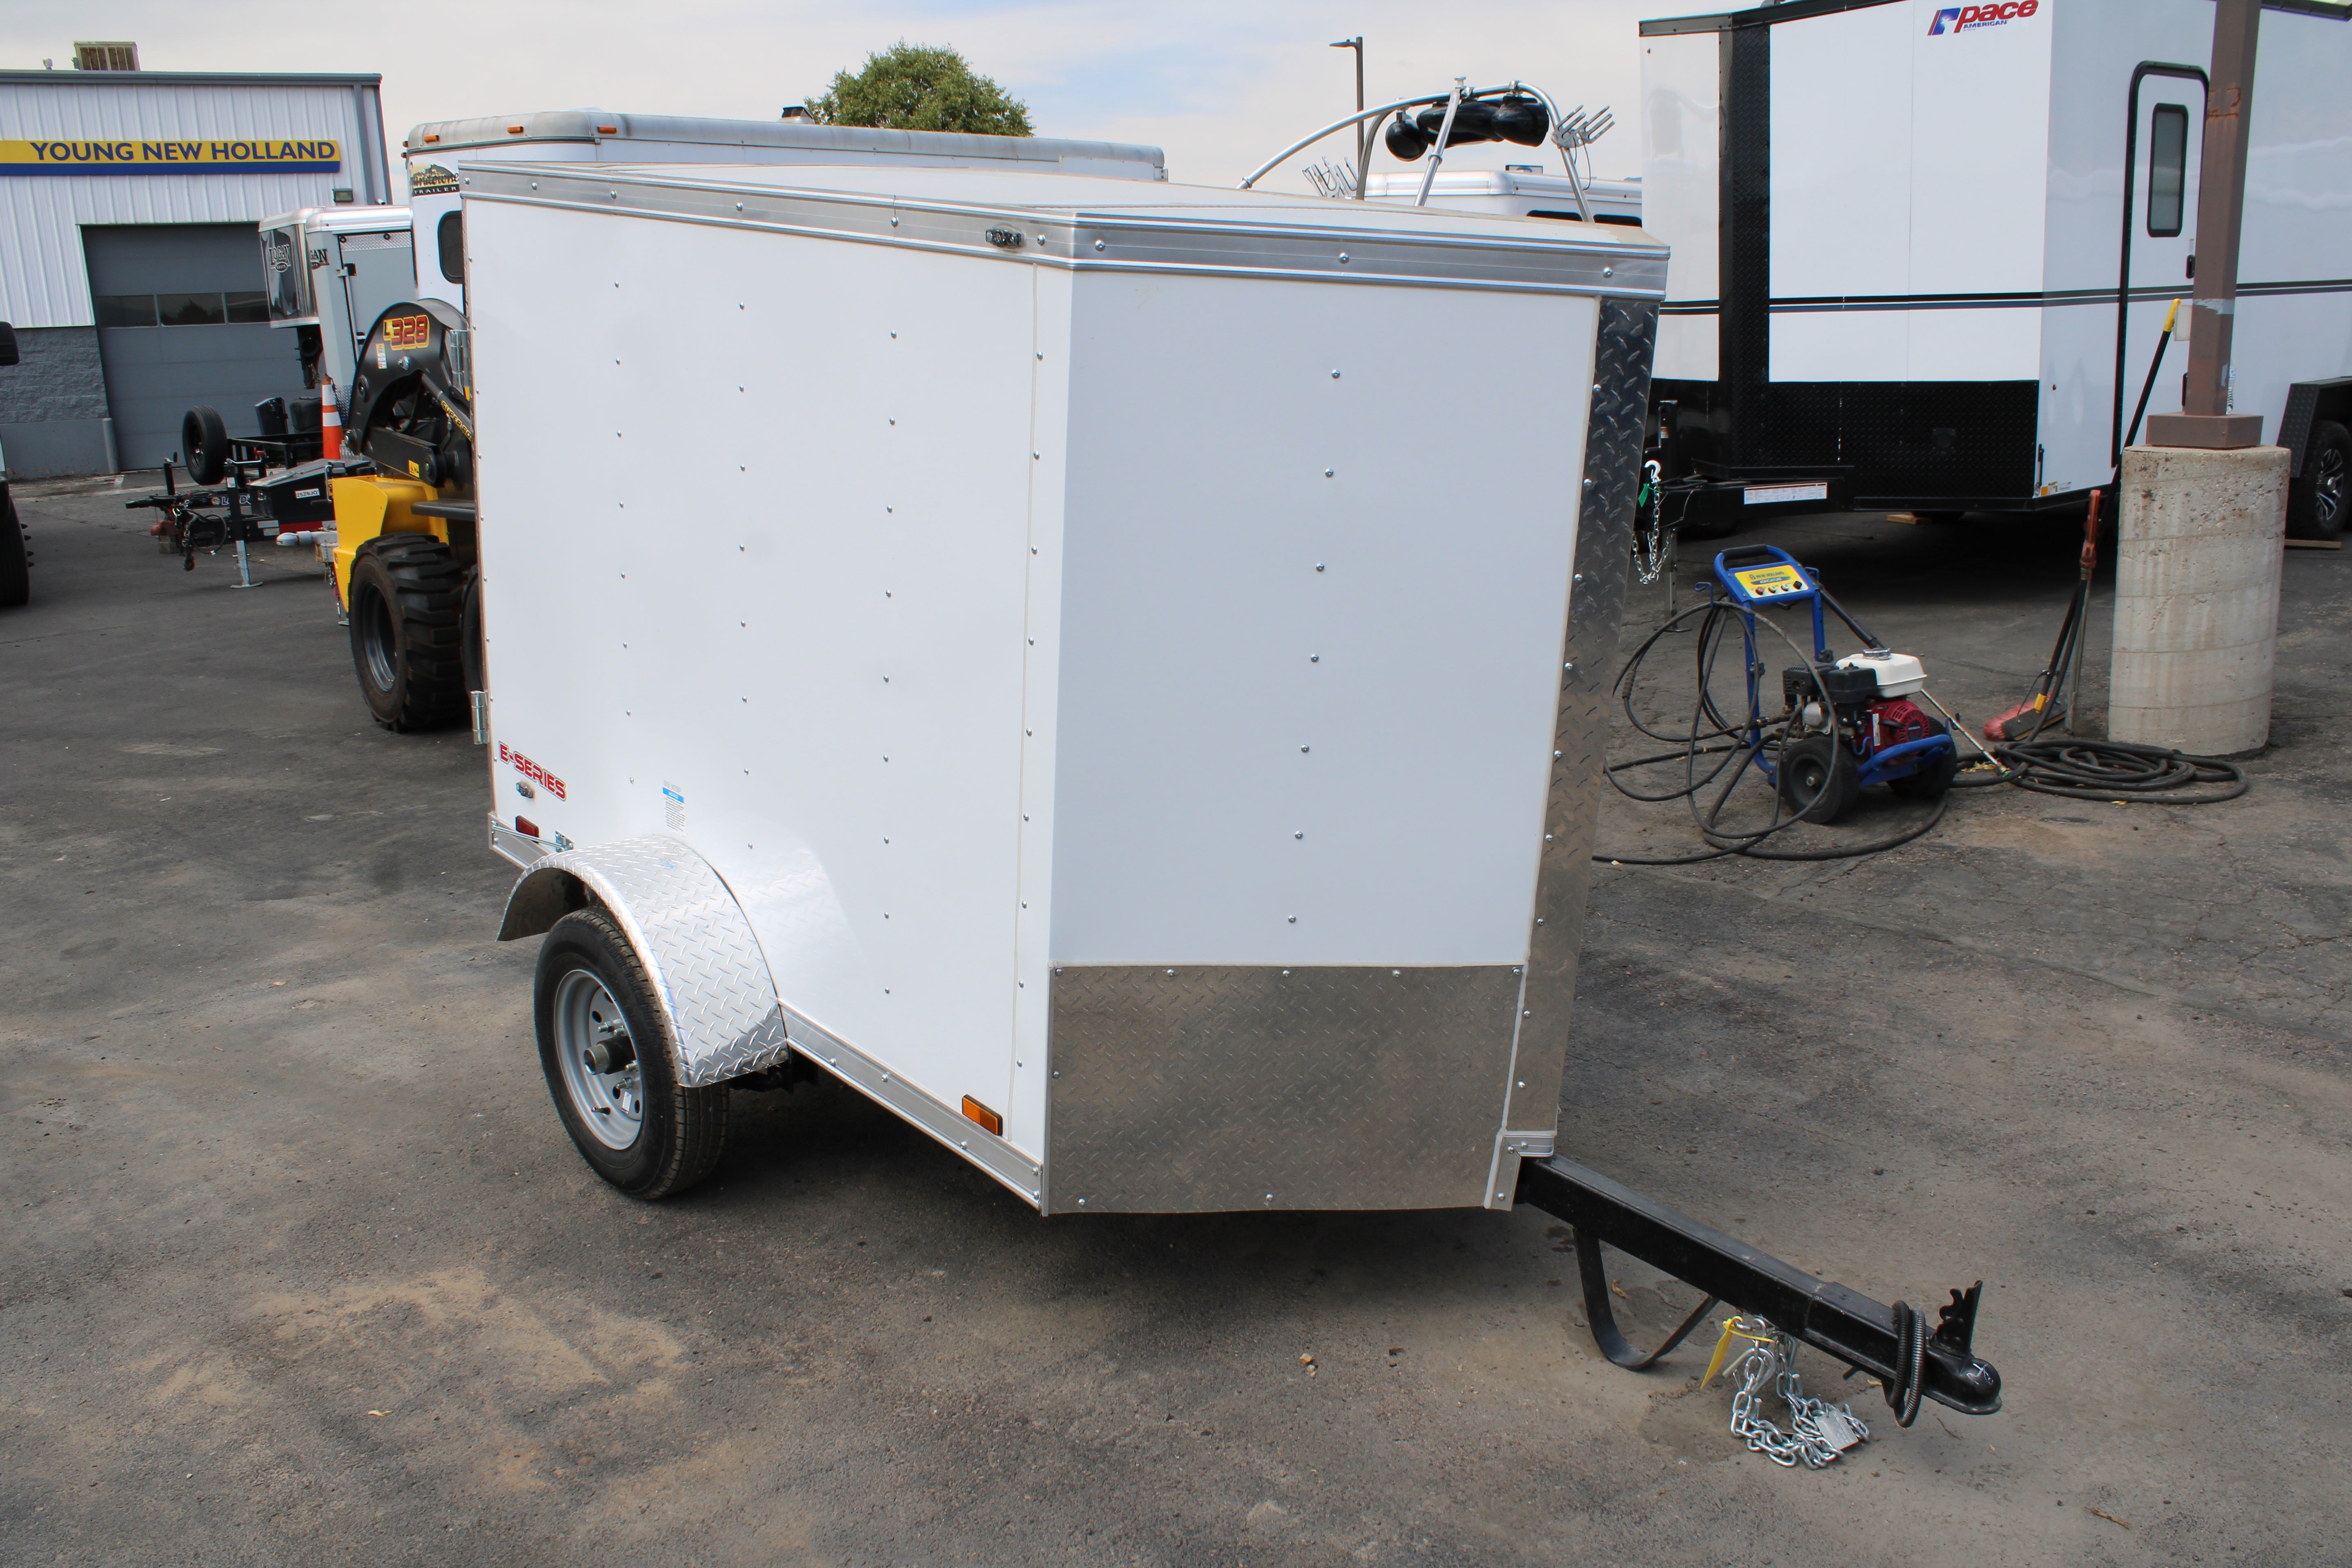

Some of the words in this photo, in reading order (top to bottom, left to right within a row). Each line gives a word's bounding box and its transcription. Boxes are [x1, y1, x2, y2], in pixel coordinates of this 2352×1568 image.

[1953, 0, 2039, 33] pace
[1963, 20, 2007, 29] AMERICAN
[30, 142, 134, 161] YOUNG
[142, 142, 203, 160] NEW
[211, 142, 335, 160] HOLLAND
[269, 245, 291, 265] LOGAN
[310, 248, 330, 265] GAN
[441, 400, 462, 428] SUPER
[461, 424, 472, 441] BO
[222, 495, 247, 505] LD
[499, 742, 566, 801] E-SERIES
